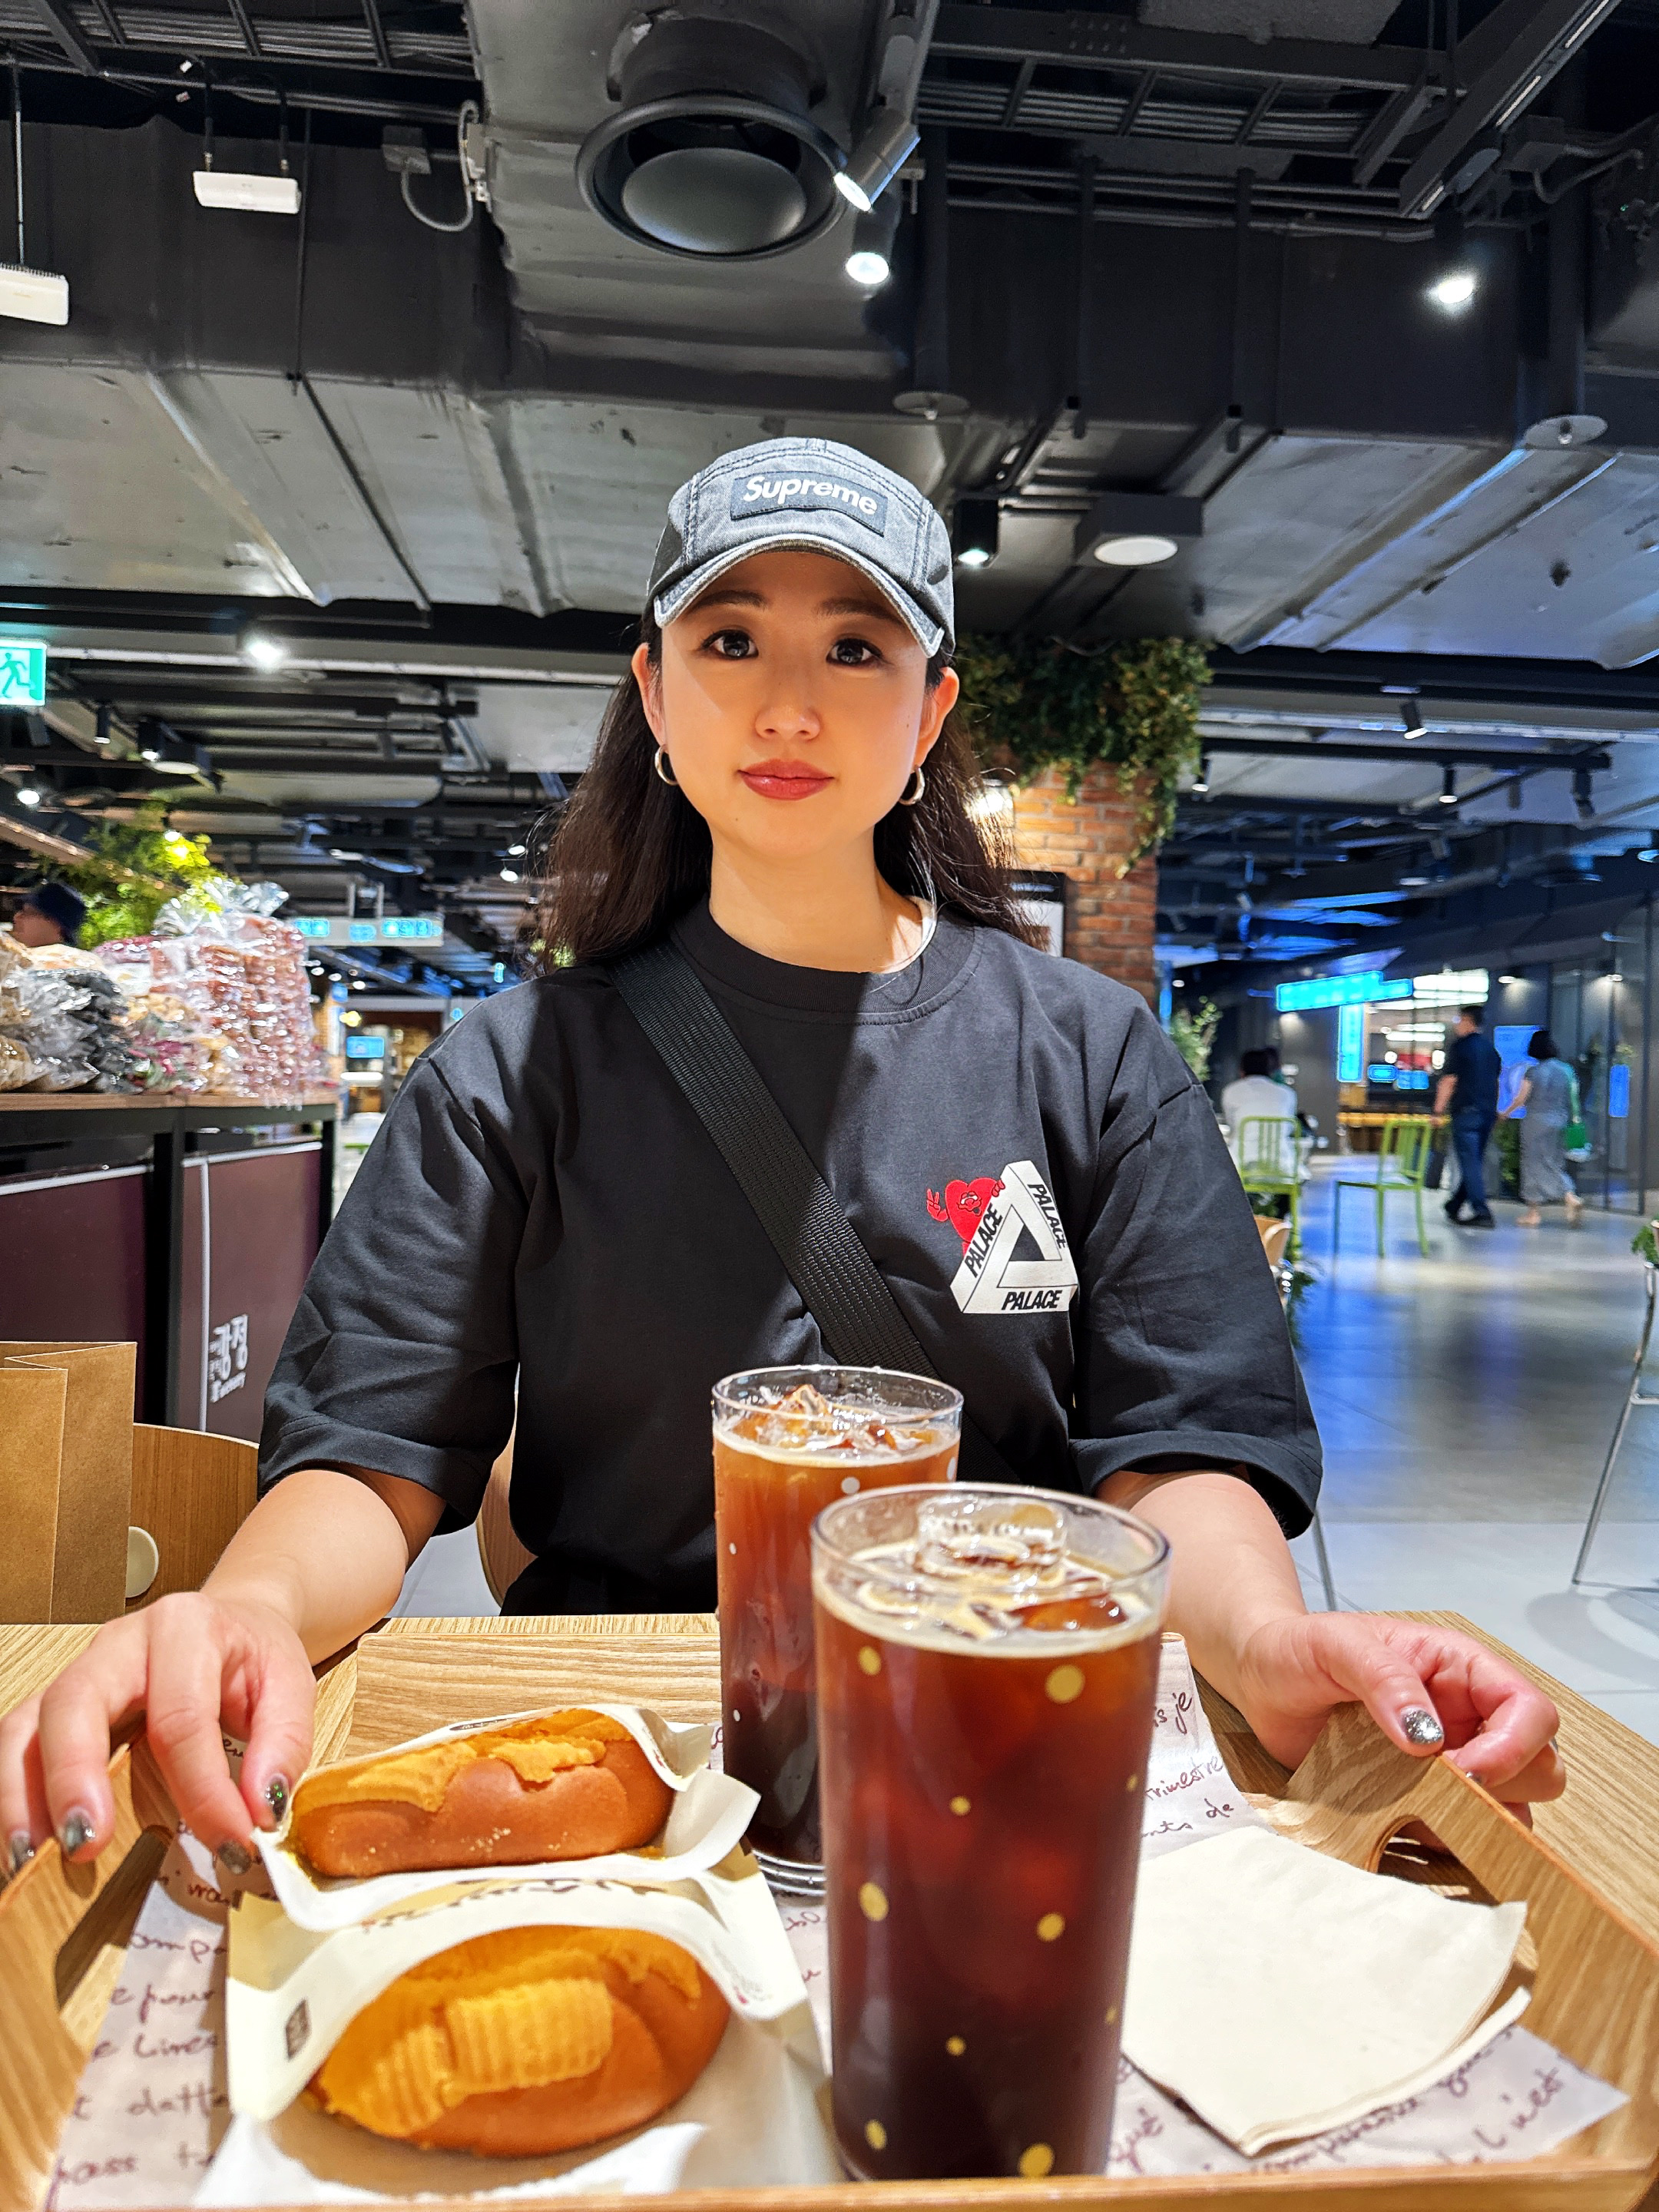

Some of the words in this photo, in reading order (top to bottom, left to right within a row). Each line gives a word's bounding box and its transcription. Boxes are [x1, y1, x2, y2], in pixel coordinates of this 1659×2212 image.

[743, 476, 878, 515] Supreme
[965, 1204, 1003, 1277] PALACE
[1028, 1184, 1066, 1249] PALACE
[1001, 1290, 1063, 1311] PALACE
